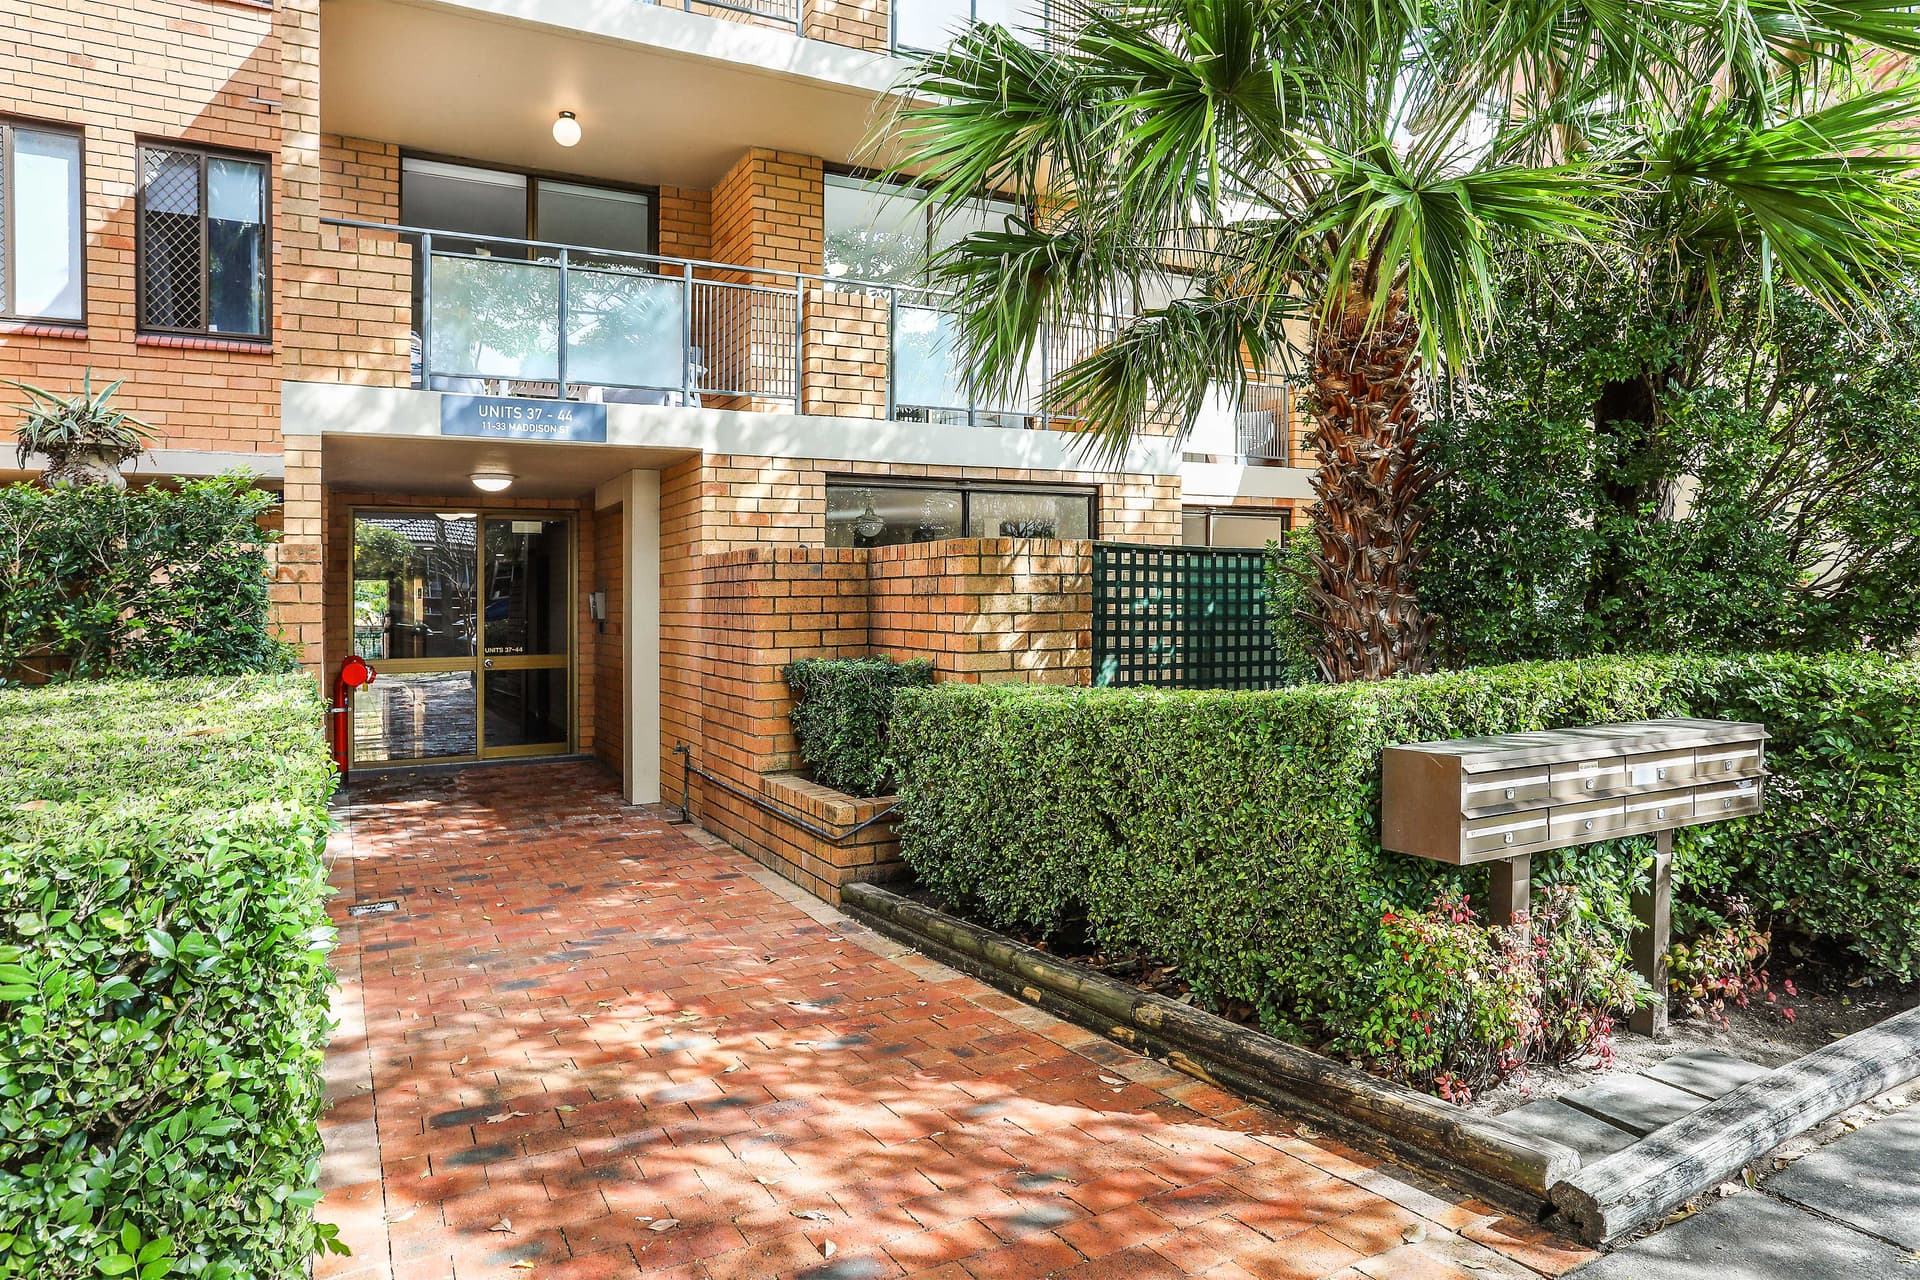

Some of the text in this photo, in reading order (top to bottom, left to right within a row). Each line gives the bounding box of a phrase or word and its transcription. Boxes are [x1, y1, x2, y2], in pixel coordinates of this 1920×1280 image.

[478, 404, 522, 419] UNITS
[527, 408, 543, 420] 37
[557, 409, 573, 422] 44
[482, 421, 571, 434] 11-33 MADDISON ST
[484, 646, 504, 654] UNITS
